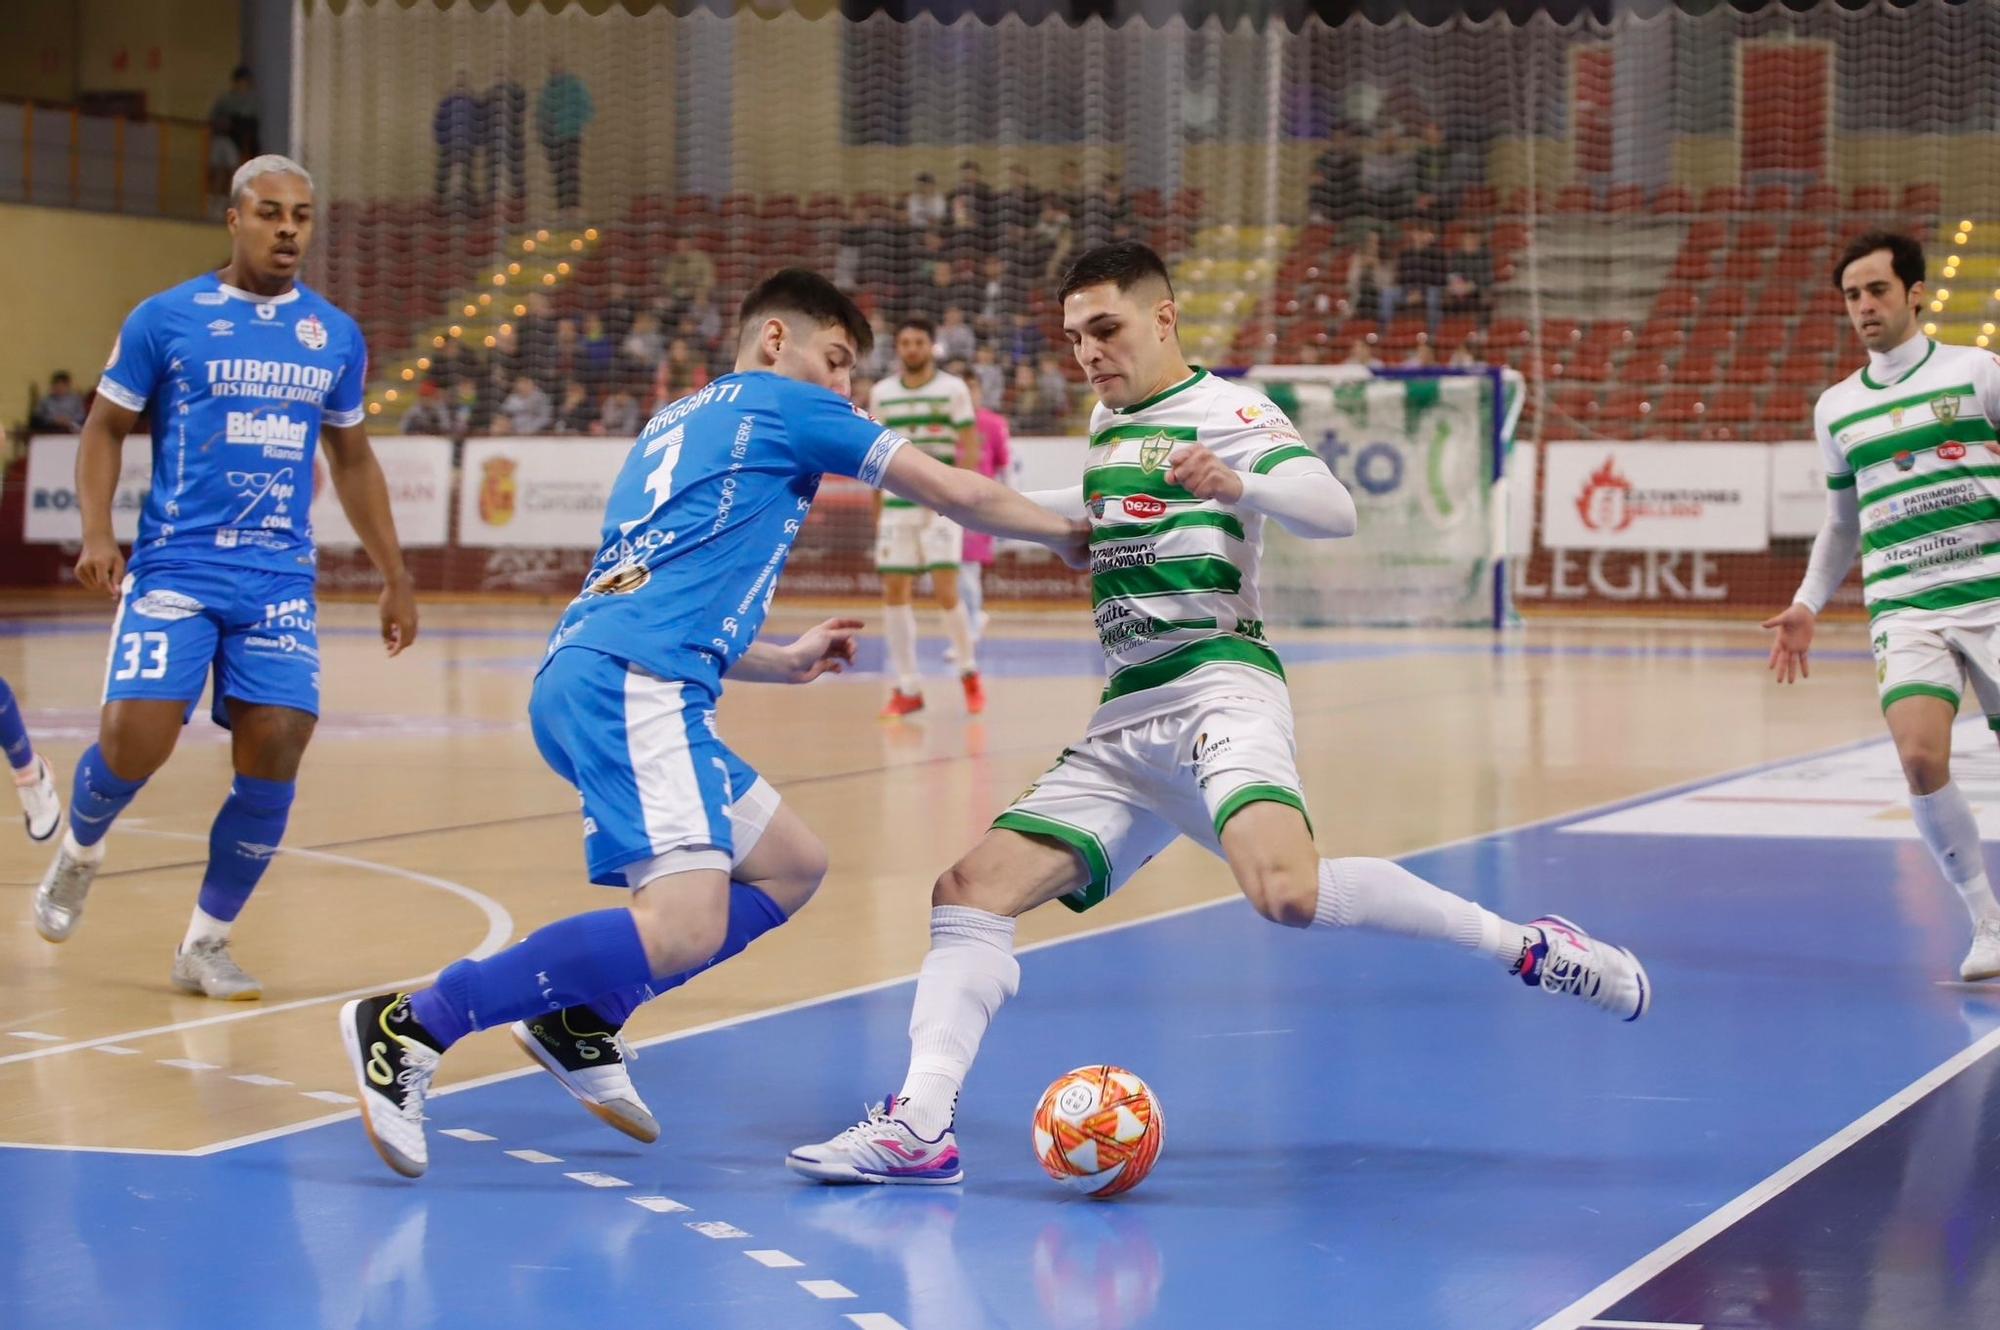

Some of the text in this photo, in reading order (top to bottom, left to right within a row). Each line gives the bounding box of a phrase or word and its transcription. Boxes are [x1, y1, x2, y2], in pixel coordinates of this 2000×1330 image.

[206, 359, 333, 392] TUBANOR
[226, 411, 308, 442] BigMat
[619, 423, 685, 535] 3
[1903, 484, 1967, 506] PATRIMONIO
[1906, 492, 1977, 516] HUMANIDAD
[116, 632, 168, 681] 33
